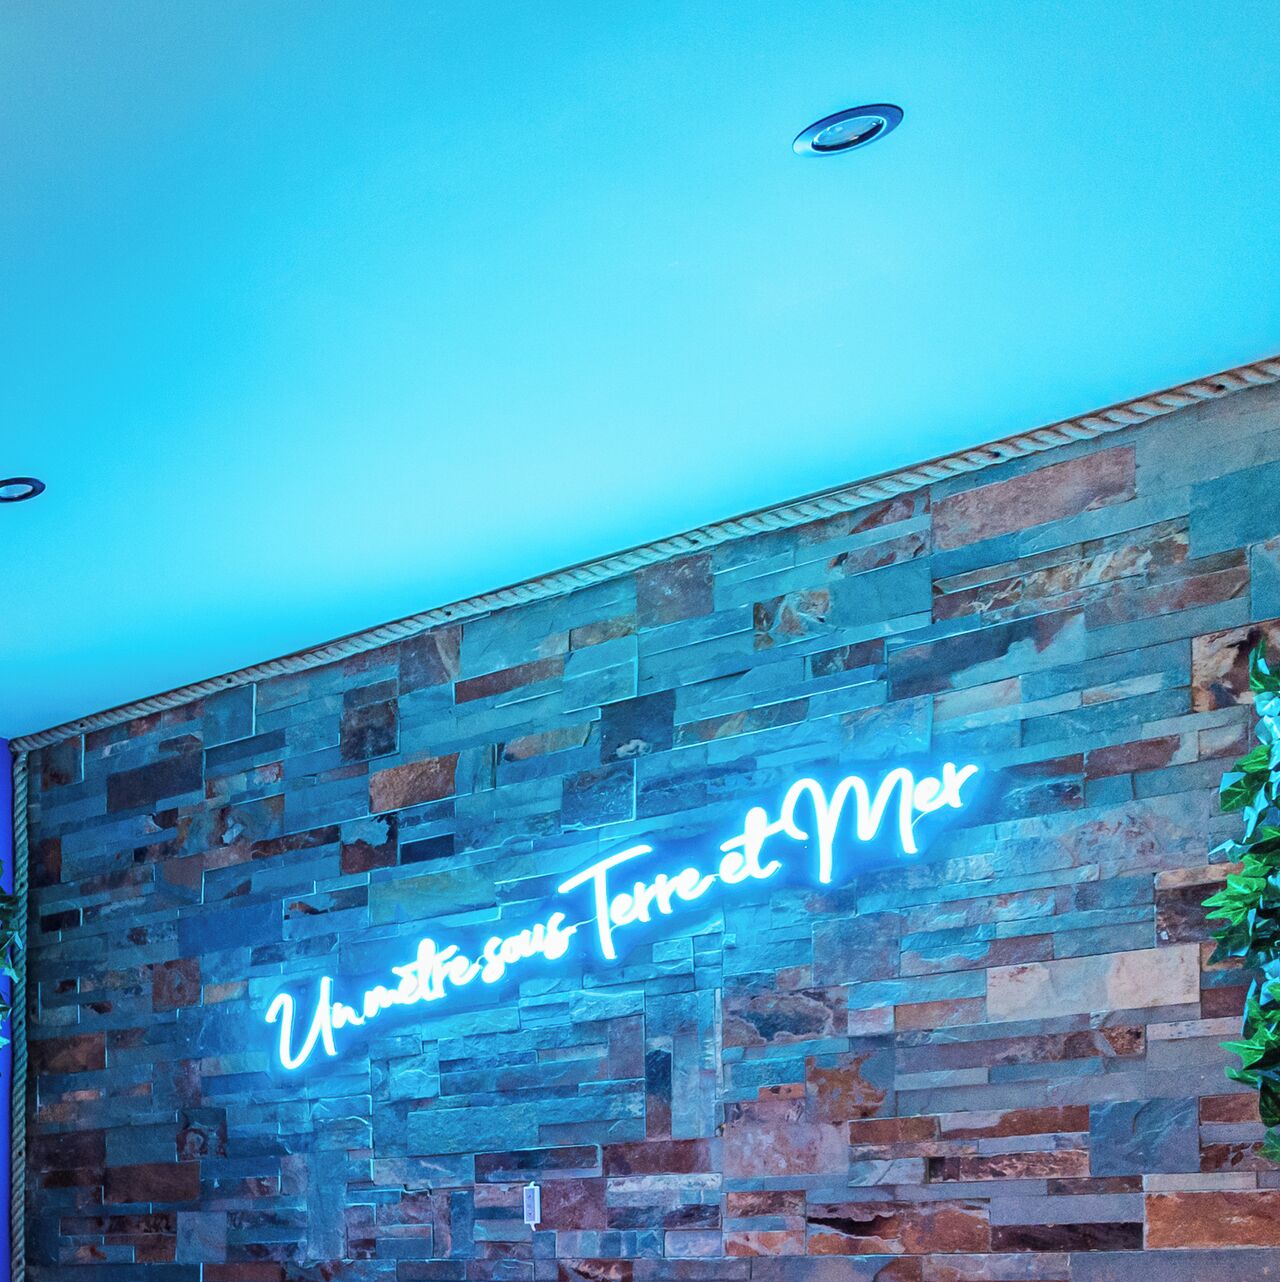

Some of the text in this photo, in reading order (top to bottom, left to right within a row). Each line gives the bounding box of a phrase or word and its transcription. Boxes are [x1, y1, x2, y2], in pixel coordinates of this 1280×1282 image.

[265, 976, 366, 1070] Un
[481, 911, 578, 984] sous
[557, 844, 717, 960] Terre
[719, 806, 784, 884] et
[780, 762, 980, 885] Mer
